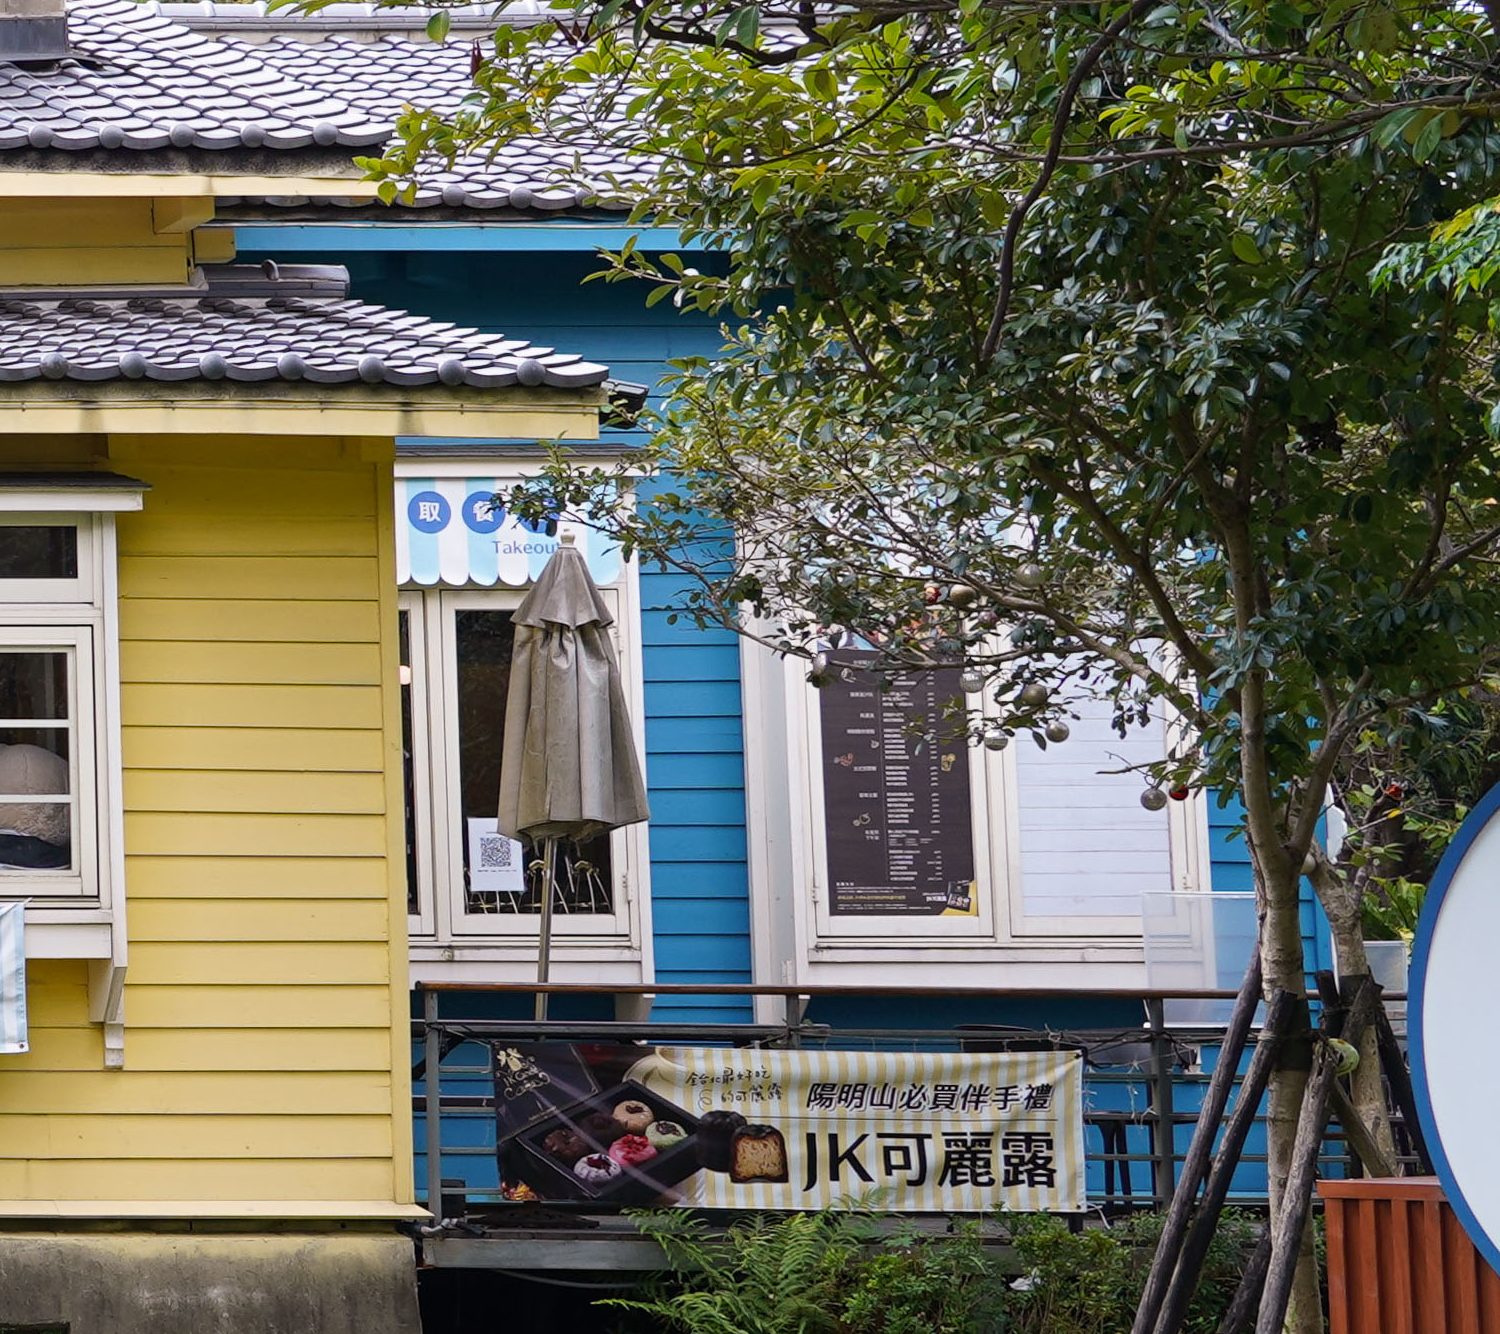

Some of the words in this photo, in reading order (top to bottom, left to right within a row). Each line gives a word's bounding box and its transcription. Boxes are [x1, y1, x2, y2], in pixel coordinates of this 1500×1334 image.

[806, 1083, 1052, 1113] 陽明山必買伴手禮
[803, 1131, 1057, 1191] JK可麗露
